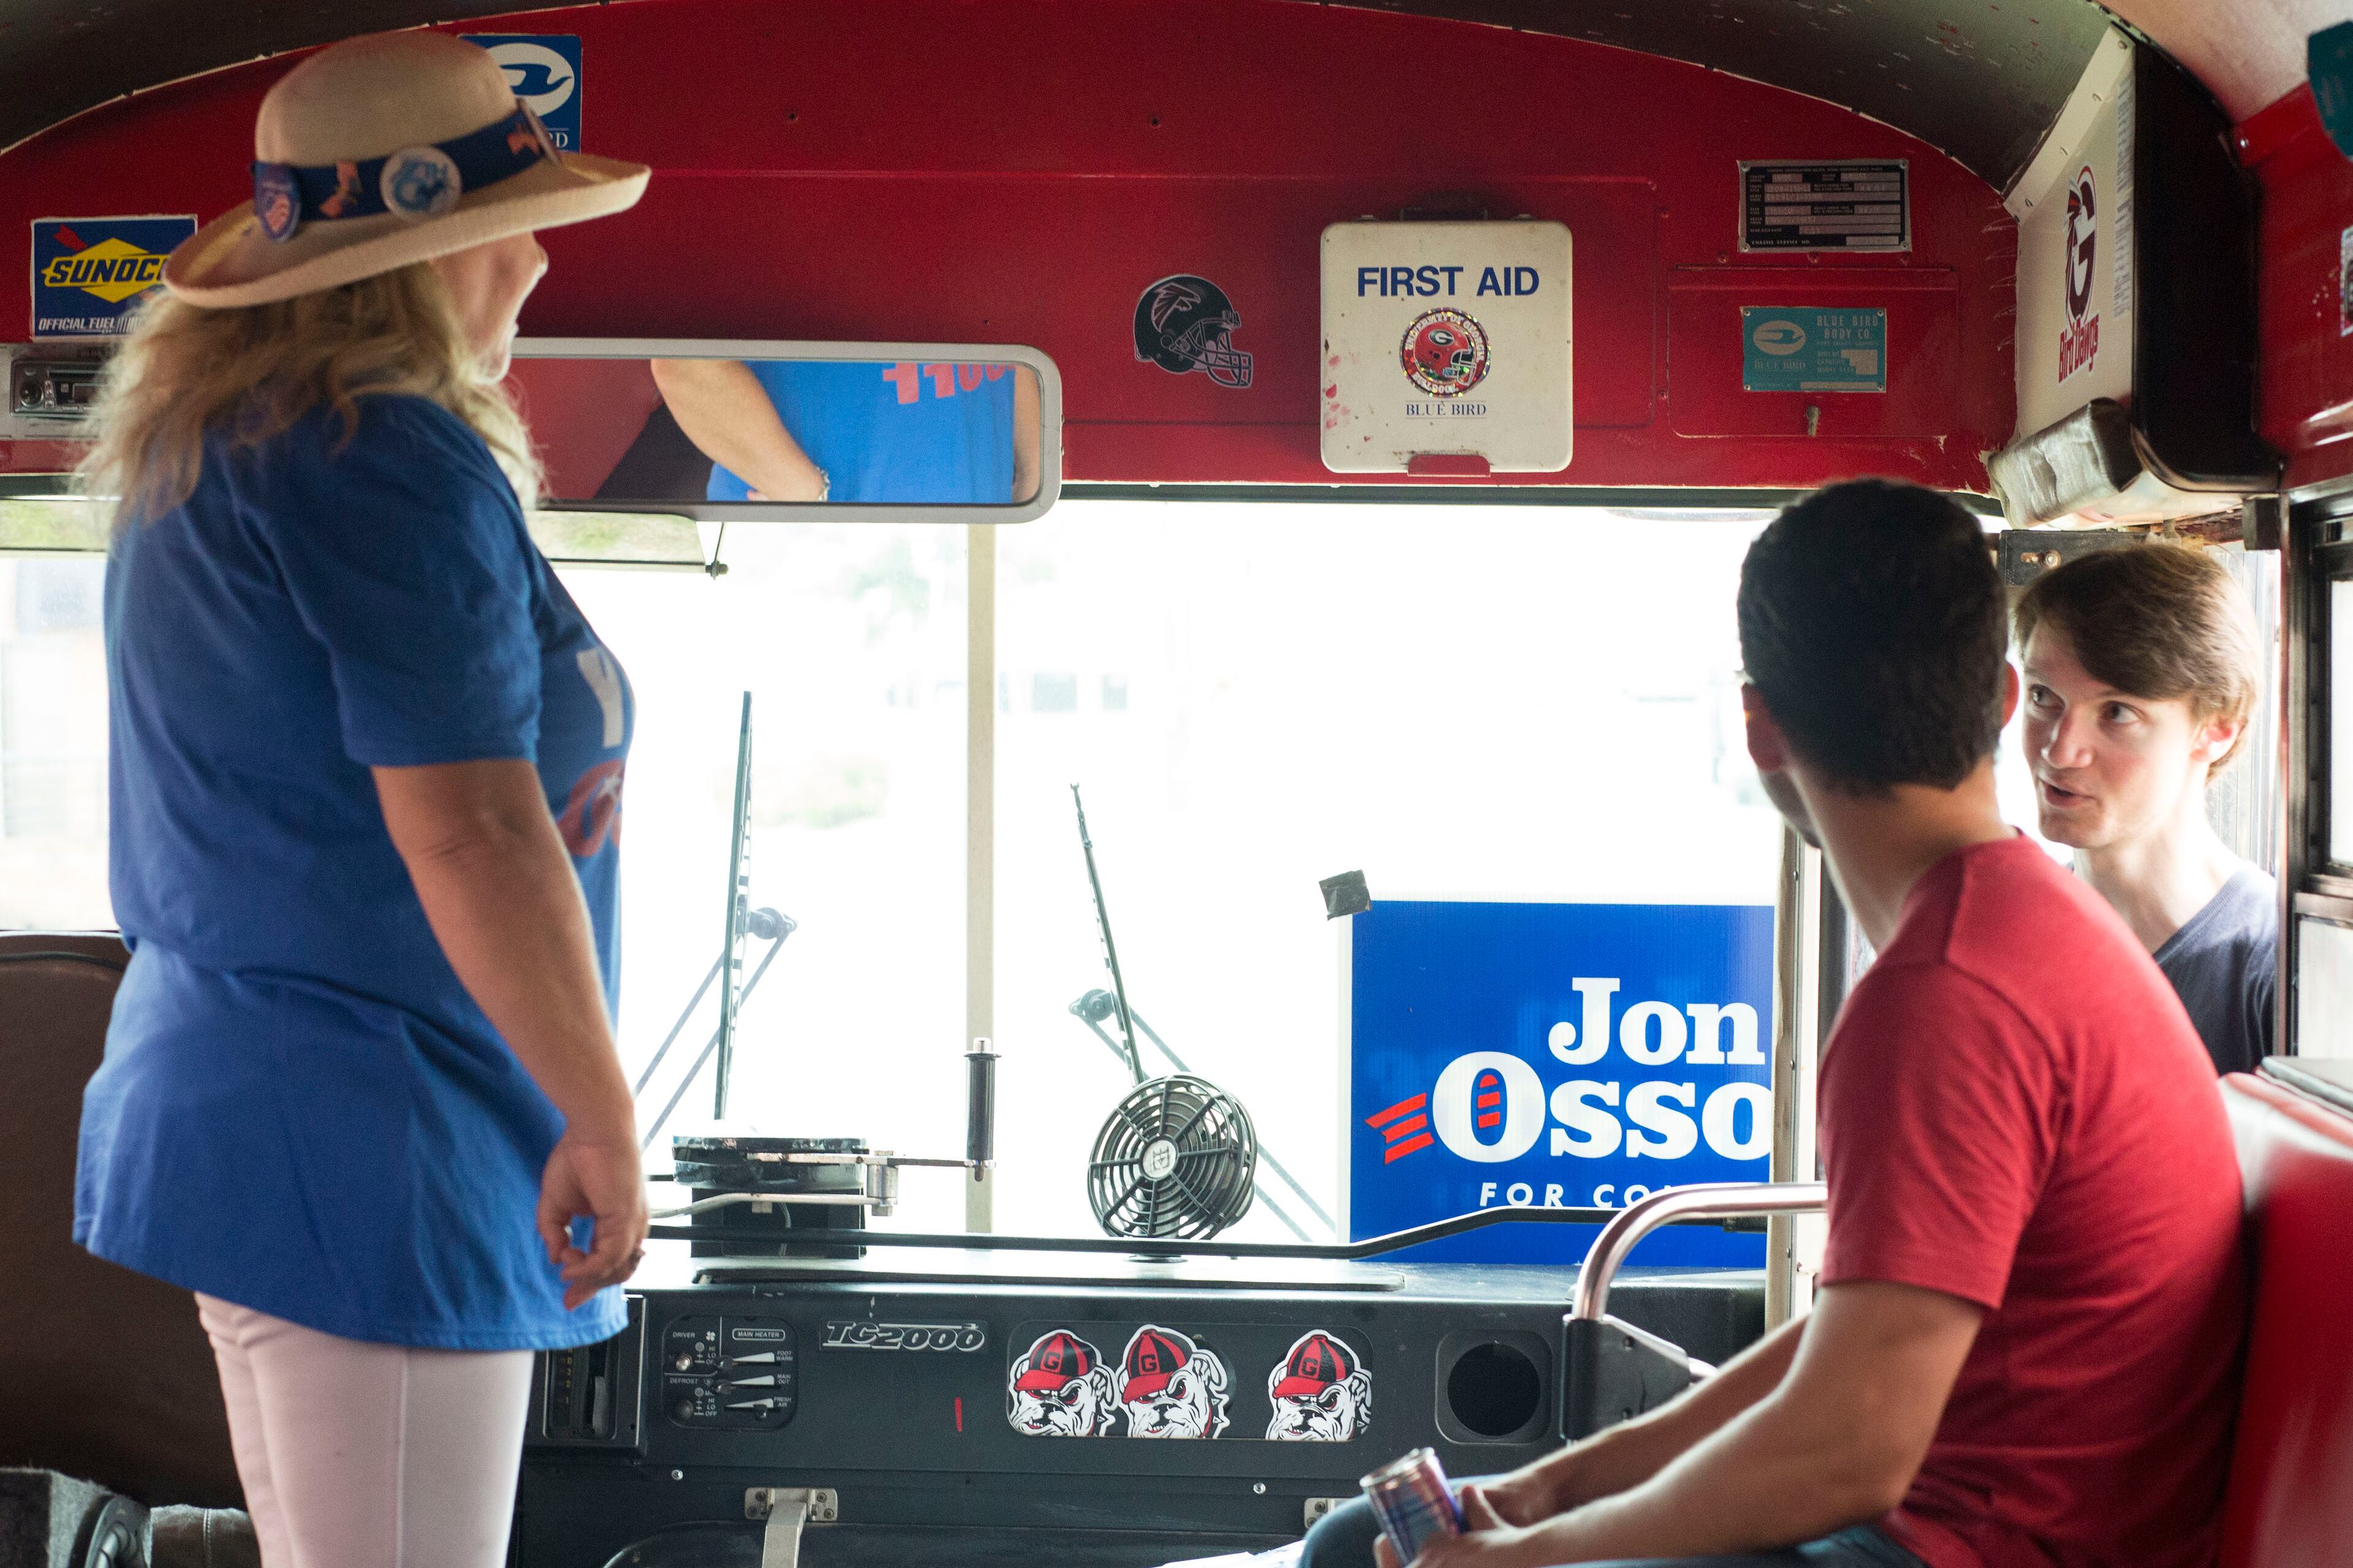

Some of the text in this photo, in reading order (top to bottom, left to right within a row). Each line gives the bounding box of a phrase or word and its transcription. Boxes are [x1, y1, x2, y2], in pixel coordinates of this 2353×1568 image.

[48, 257, 167, 284] SUNOC
[1357, 265, 1540, 297] FIRST AID
[38, 317, 115, 331] OFFICIAL FUEL
[1817, 315, 1878, 327] BLUE BIRD
[1462, 319, 1485, 363] GEORGIA
[1824, 328, 1851, 339] BODY
[1406, 404, 1487, 416] BLUE BIRD
[1548, 977, 1765, 1066] Jon
[1479, 1182, 1673, 1208] FOR CO
[823, 1320, 985, 1352] TC2000
[1044, 1352, 1061, 1370] G
[1140, 1354, 1158, 1374] G
[1302, 1357, 1319, 1375] G
